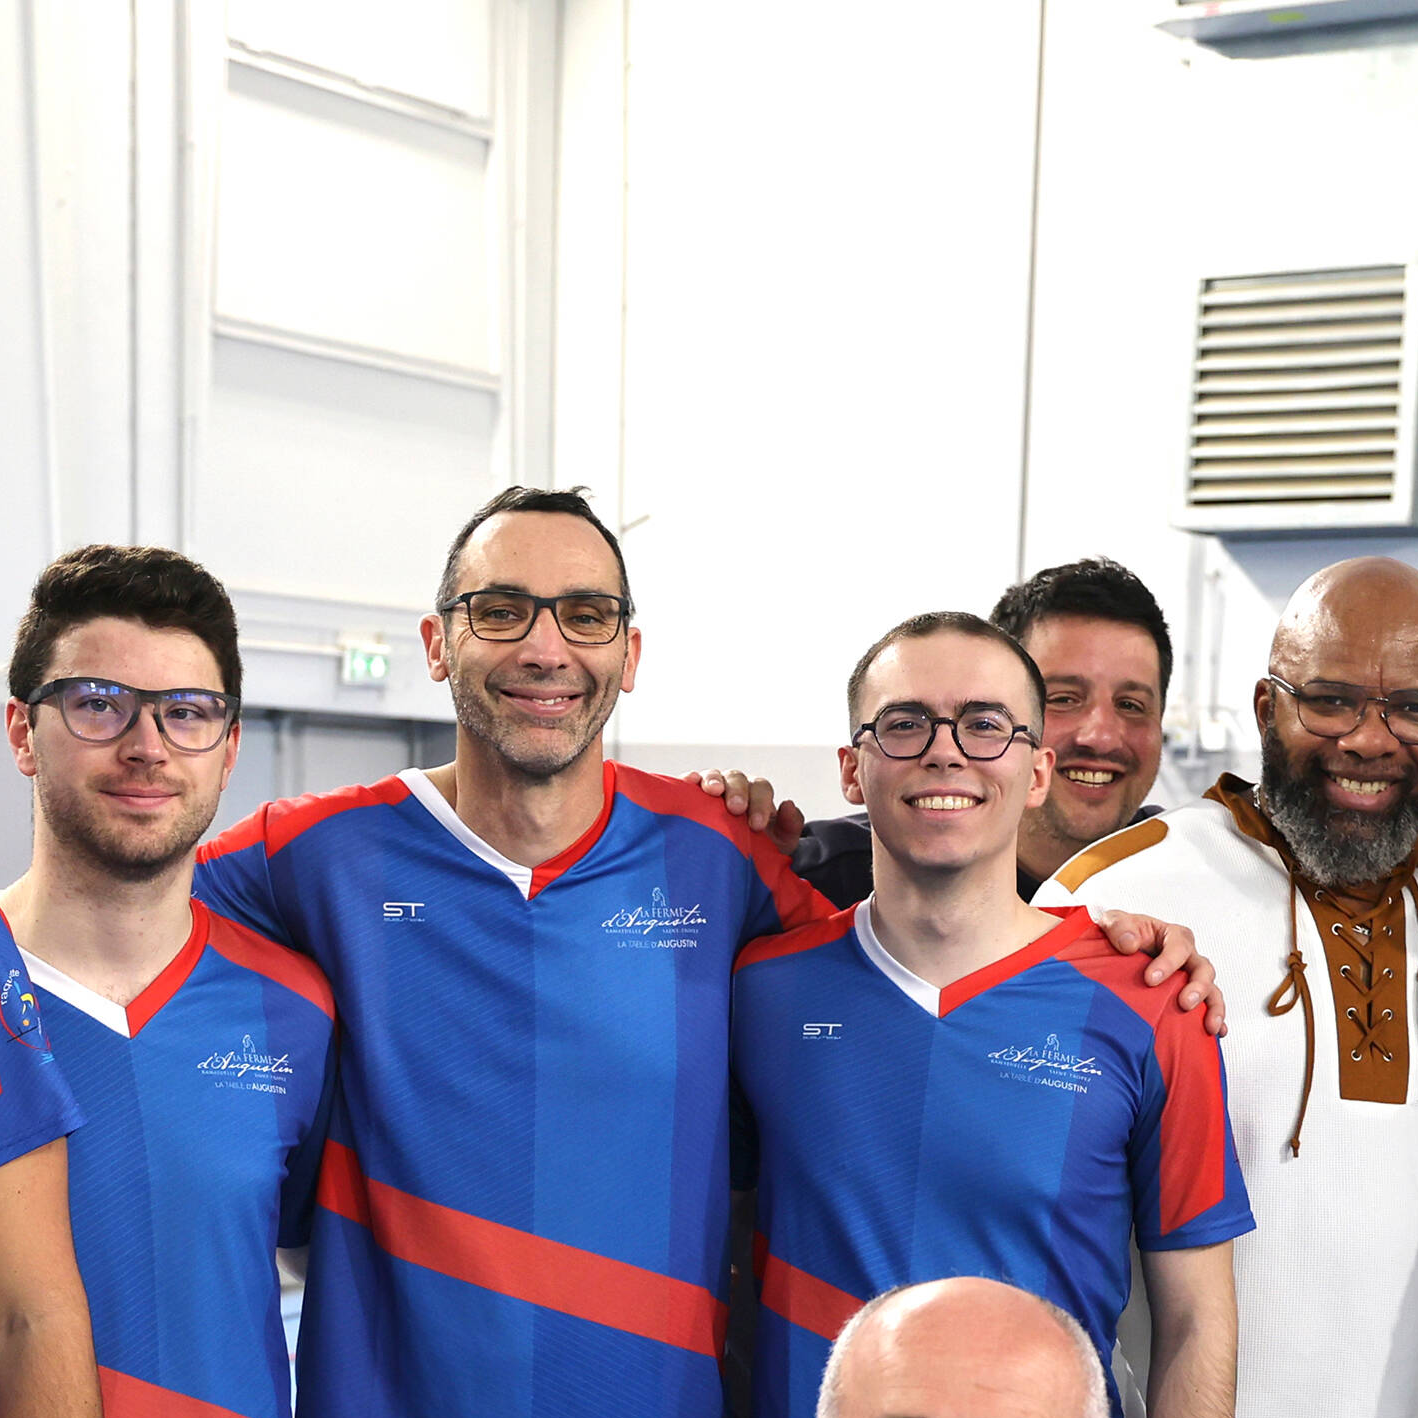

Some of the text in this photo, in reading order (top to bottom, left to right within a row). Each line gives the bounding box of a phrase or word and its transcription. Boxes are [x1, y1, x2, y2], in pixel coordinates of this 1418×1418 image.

[383, 902, 425, 917] ST
[652, 907, 684, 919] FERME
[803, 1023, 843, 1036] ST
[244, 1053, 273, 1065] FERME
[1042, 1049, 1075, 1065] FERME
